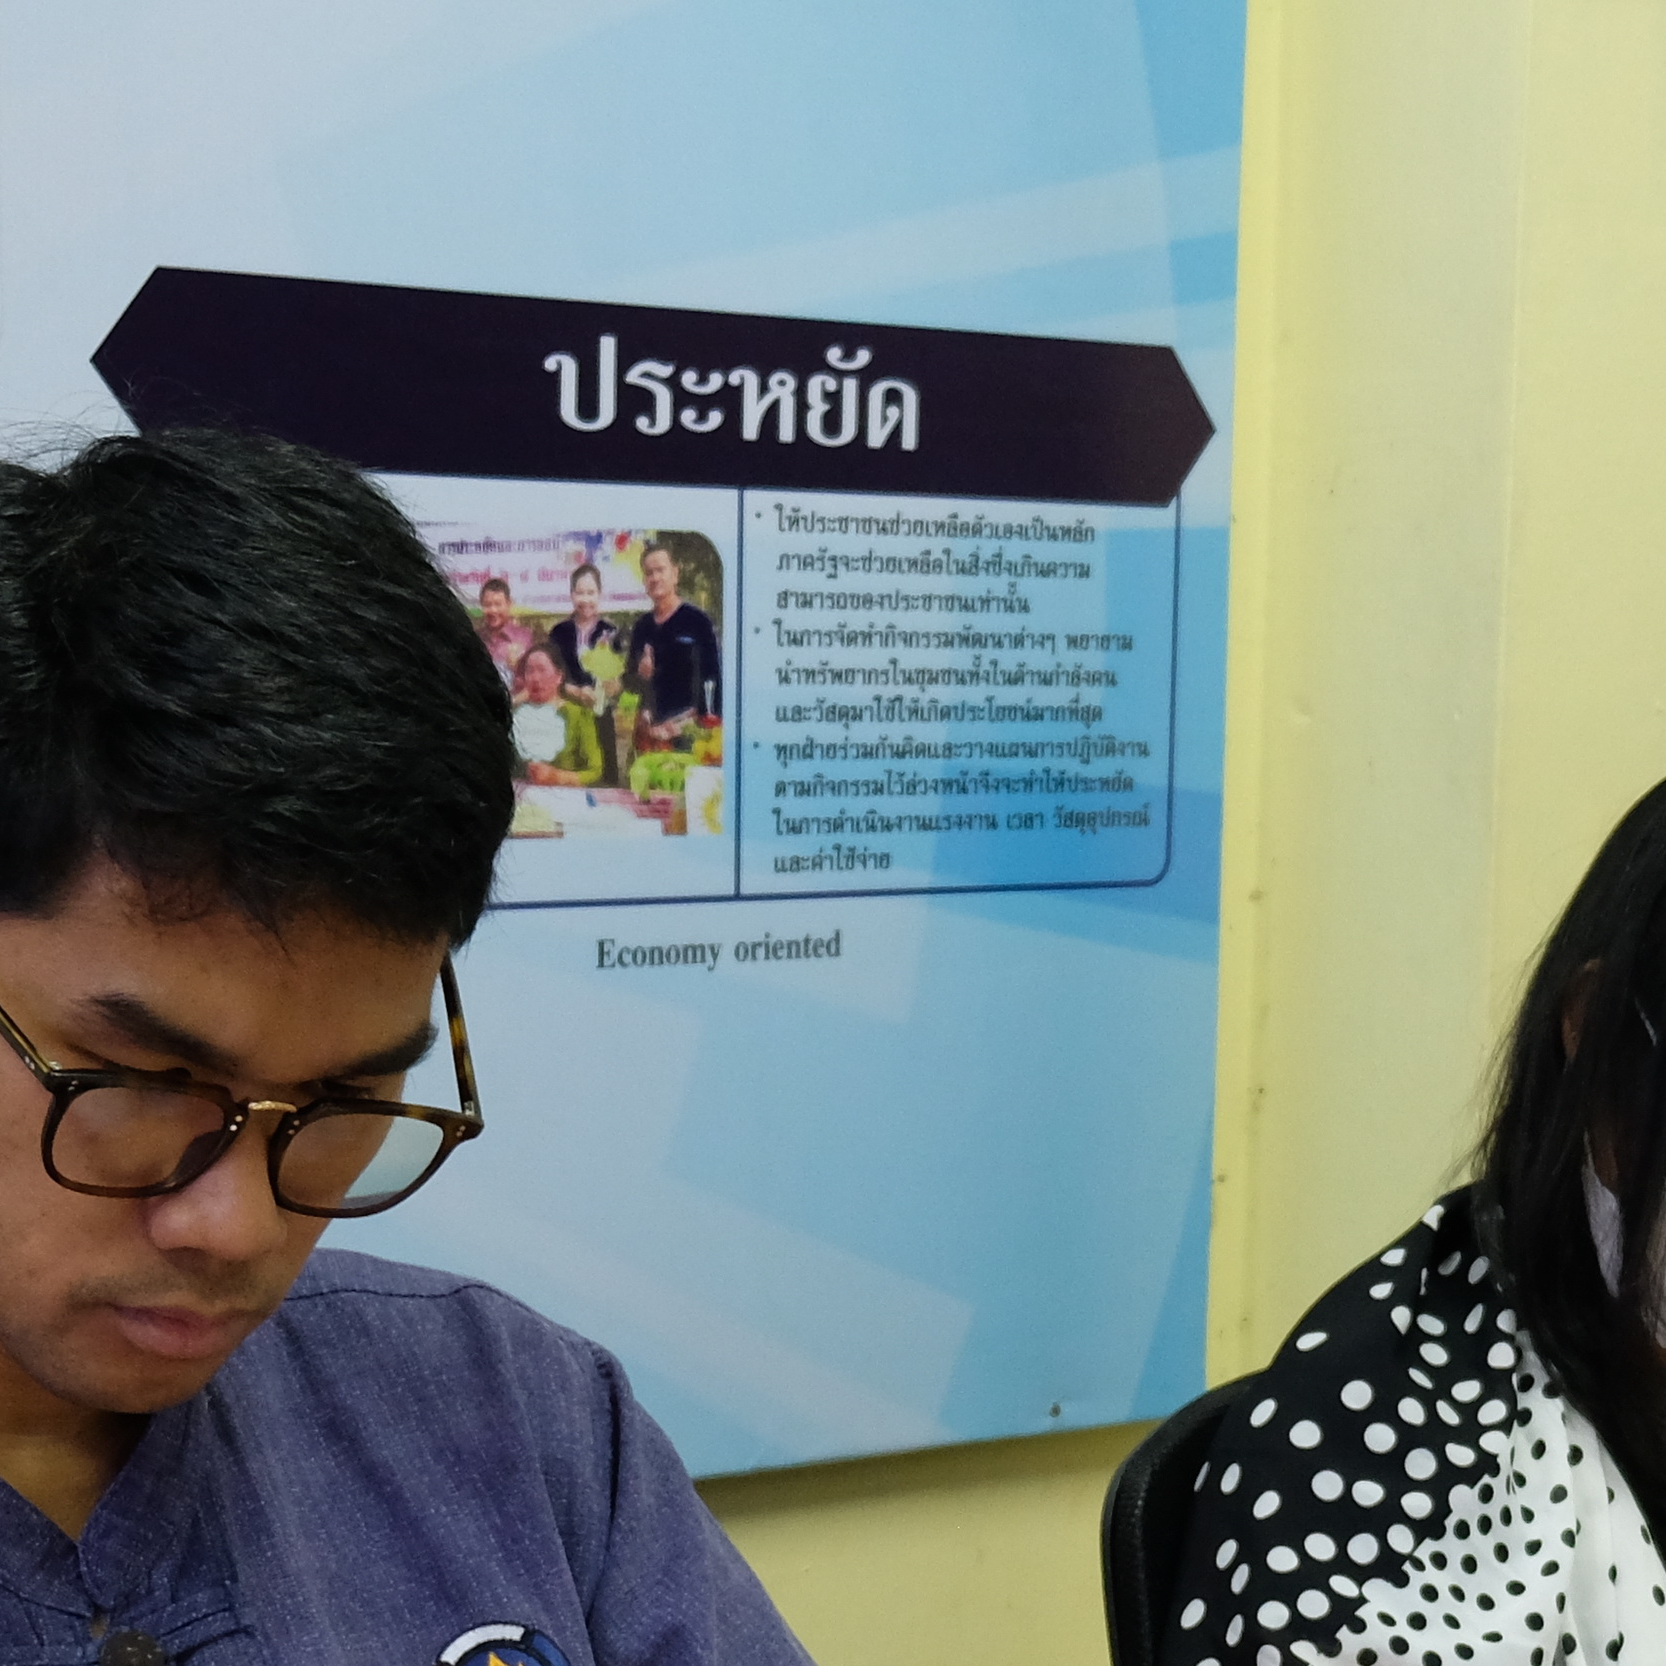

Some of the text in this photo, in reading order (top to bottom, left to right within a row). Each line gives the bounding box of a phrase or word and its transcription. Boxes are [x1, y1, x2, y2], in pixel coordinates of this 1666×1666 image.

[544, 334, 920, 451] ประหยัด
[595, 929, 841, 971] Economy oriented
